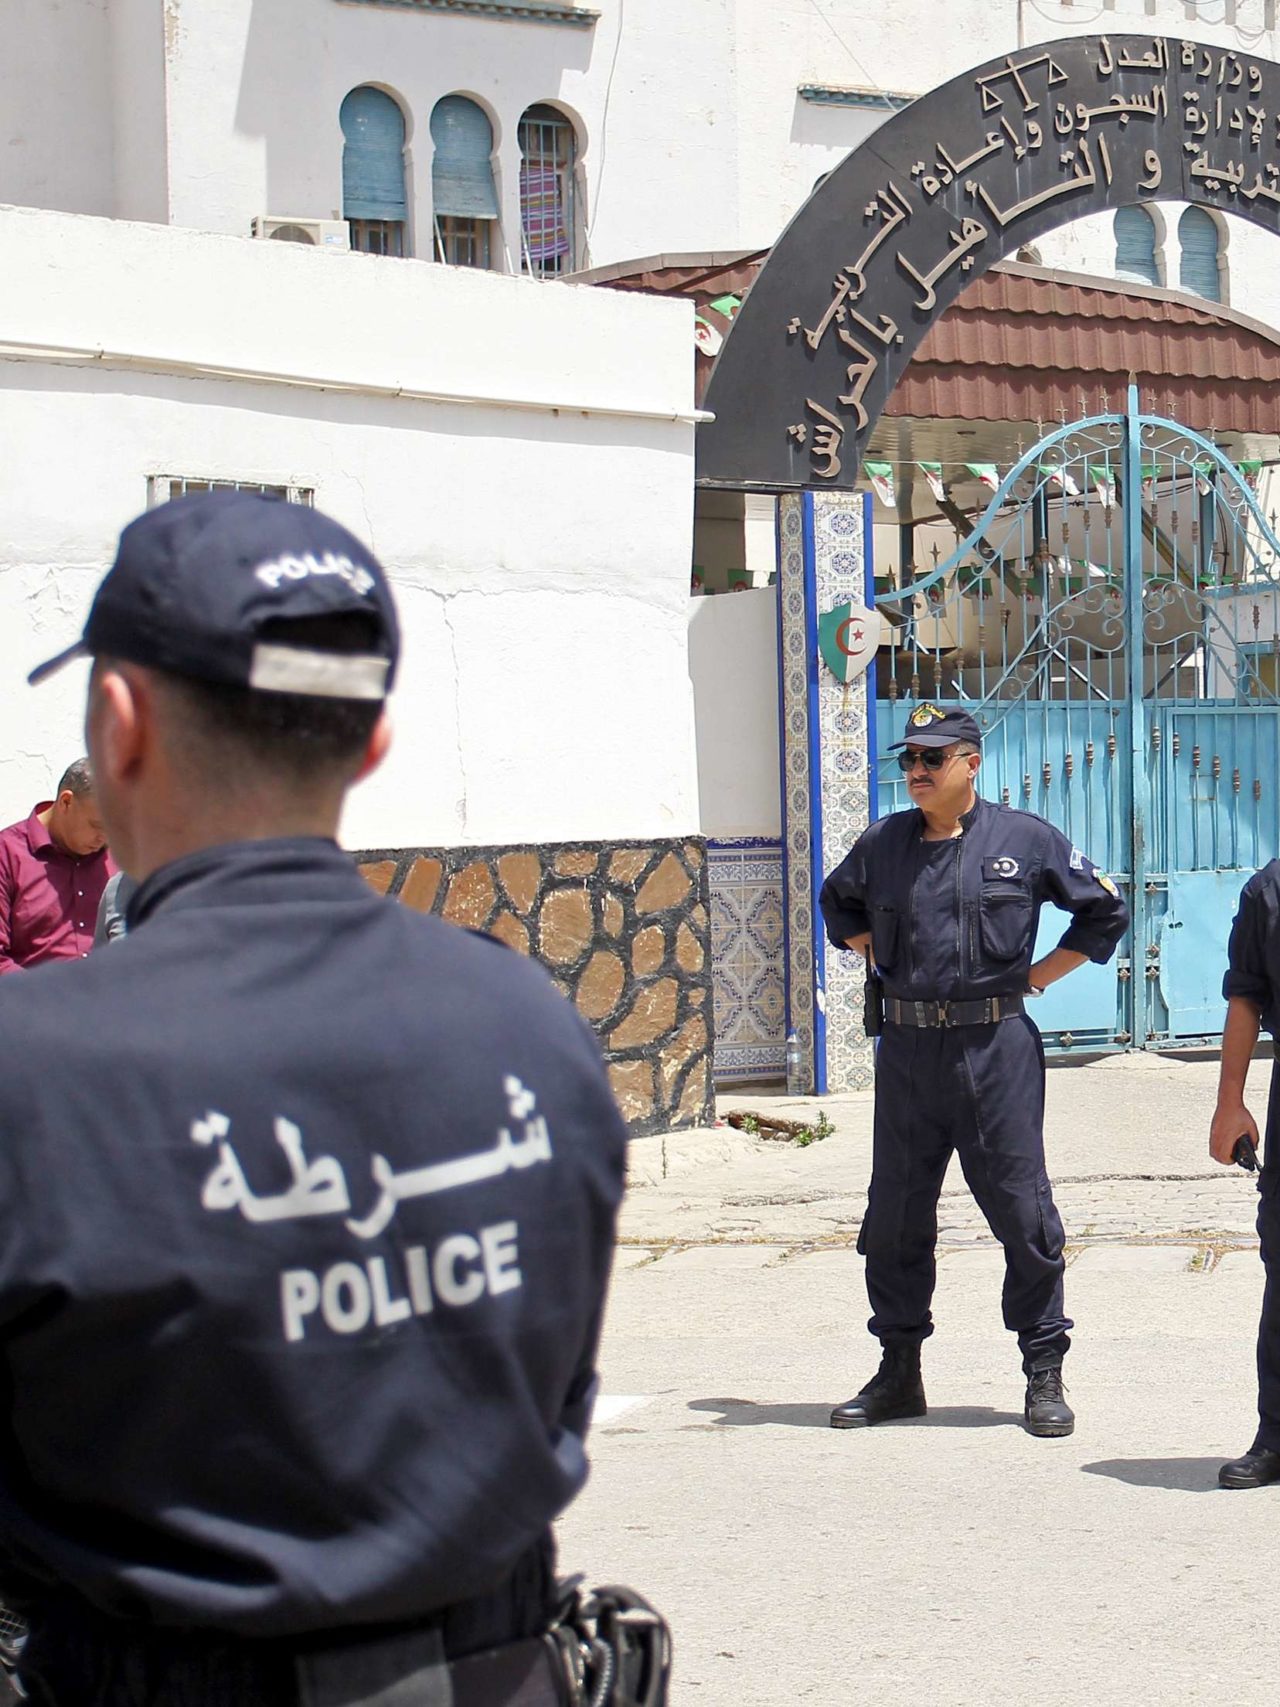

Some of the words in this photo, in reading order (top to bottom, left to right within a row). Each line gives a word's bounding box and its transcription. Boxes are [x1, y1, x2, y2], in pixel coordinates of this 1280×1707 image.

[1098, 36, 1169, 74] العدل
[1181, 41, 1263, 93] وزارة
[1055, 85, 1169, 134] السجون
[1182, 91, 1267, 144] لإدارة
[911, 116, 1043, 196] وإعادة
[1137, 150, 1161, 189] و
[897, 133, 1112, 310] التأهيل
[787, 181, 913, 350] التربية
[787, 308, 904, 478] بالحراش
[190, 1074, 552, 1240] شرطة
[281, 1221, 523, 1342] POLICE
